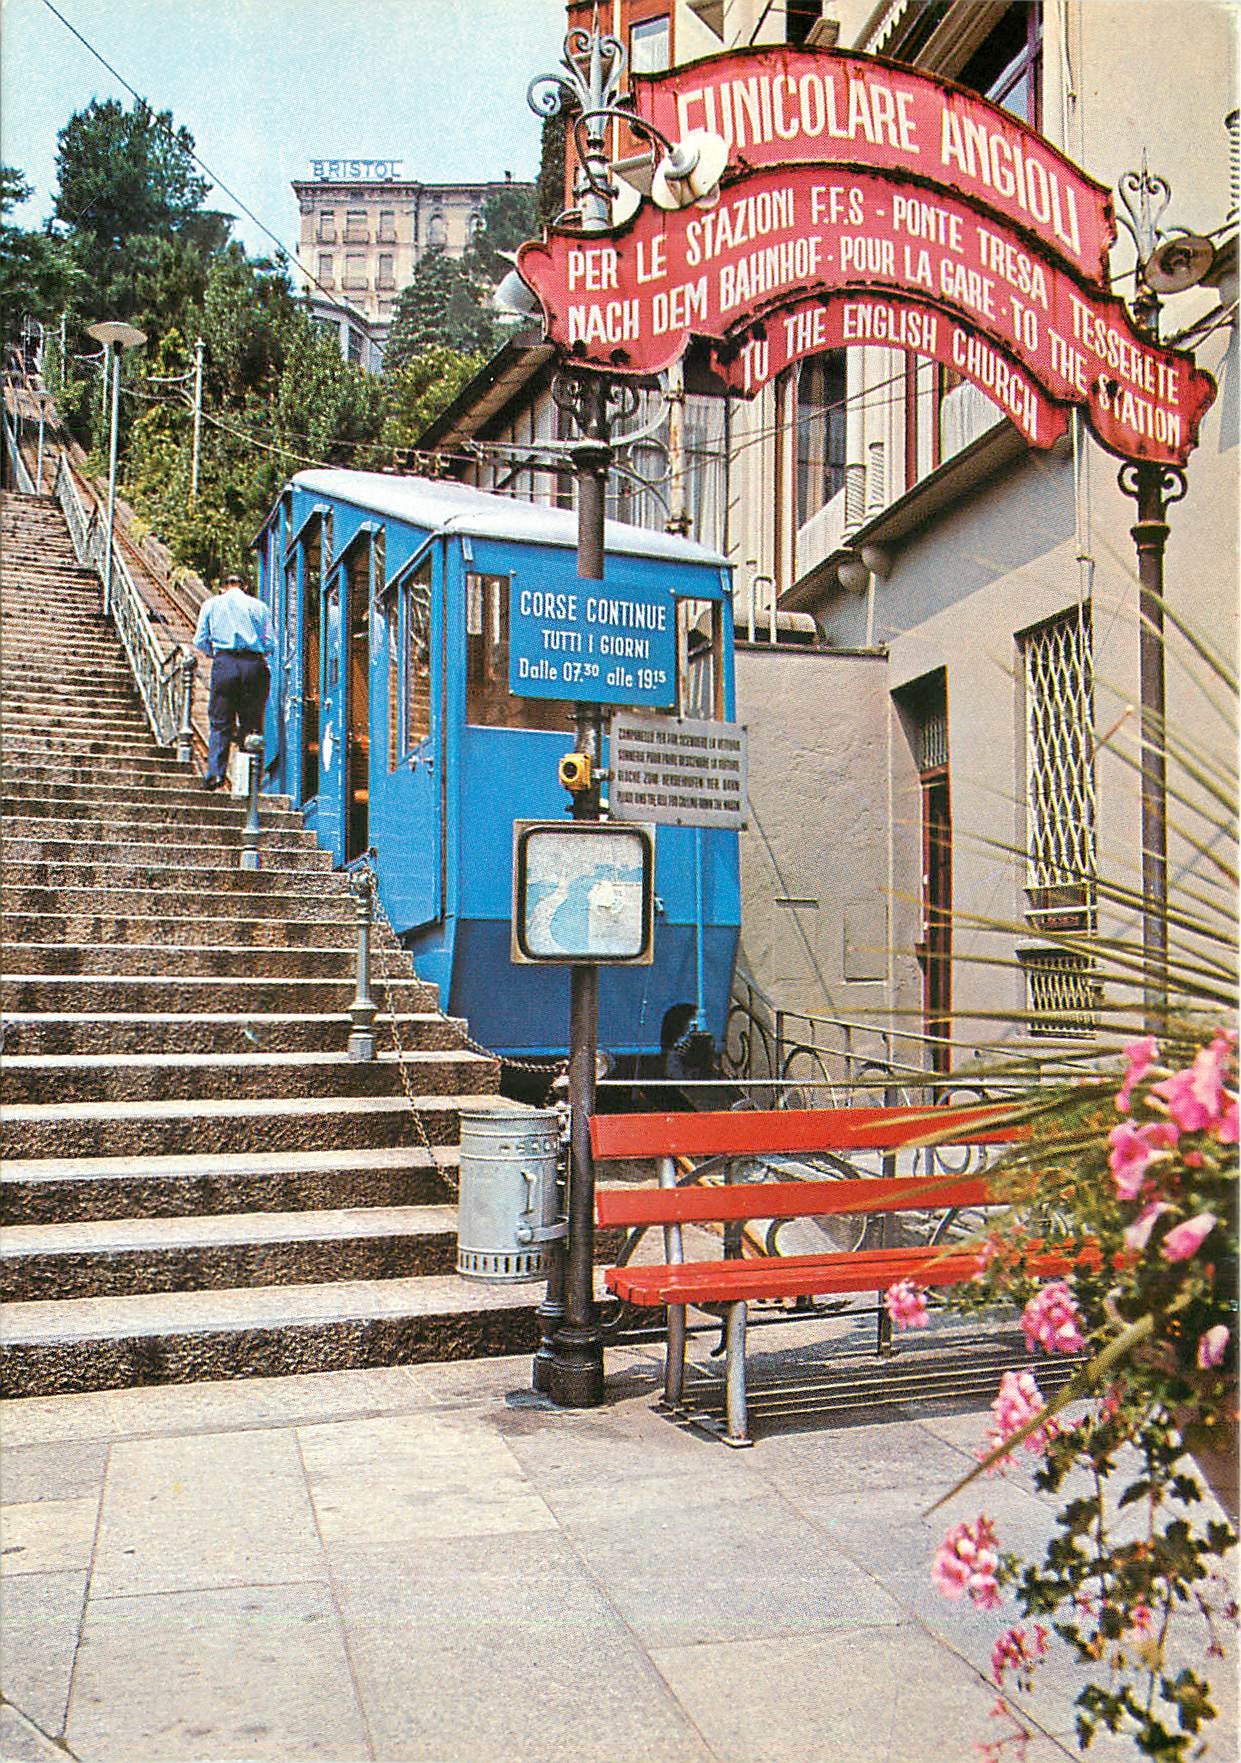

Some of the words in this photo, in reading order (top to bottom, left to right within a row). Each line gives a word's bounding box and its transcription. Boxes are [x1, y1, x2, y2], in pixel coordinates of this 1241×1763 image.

[313, 161, 401, 178] BRISTOL
[678, 74, 920, 153] FUNICOLARE
[941, 107, 1081, 256] ANGIOLI
[568, 248, 619, 292] PER
[637, 234, 667, 284] LE
[686, 187, 794, 266] STAZIONI
[893, 194, 964, 254] PONTE
[976, 226, 1048, 312] TRESA
[1069, 292, 1179, 405] TESSERETE
[568, 298, 640, 344] NACH
[653, 276, 708, 336] DEM
[840, 236, 895, 278] POUR
[904, 244, 933, 289] LA
[1010, 295, 1038, 352] TO
[1047, 327, 1089, 397] THE
[783, 307, 828, 360] THE
[842, 303, 938, 355] ENGLISH
[952, 328, 1039, 441] CHURCH
[520, 590, 578, 622] CORSE
[586, 597, 667, 631] CONTINUE
[541, 629, 582, 653] TUTTI
[588, 634, 594, 654] I
[600, 635, 650, 660] GIORNI
[519, 657, 558, 681] Dalle
[606, 667, 634, 688] alle
